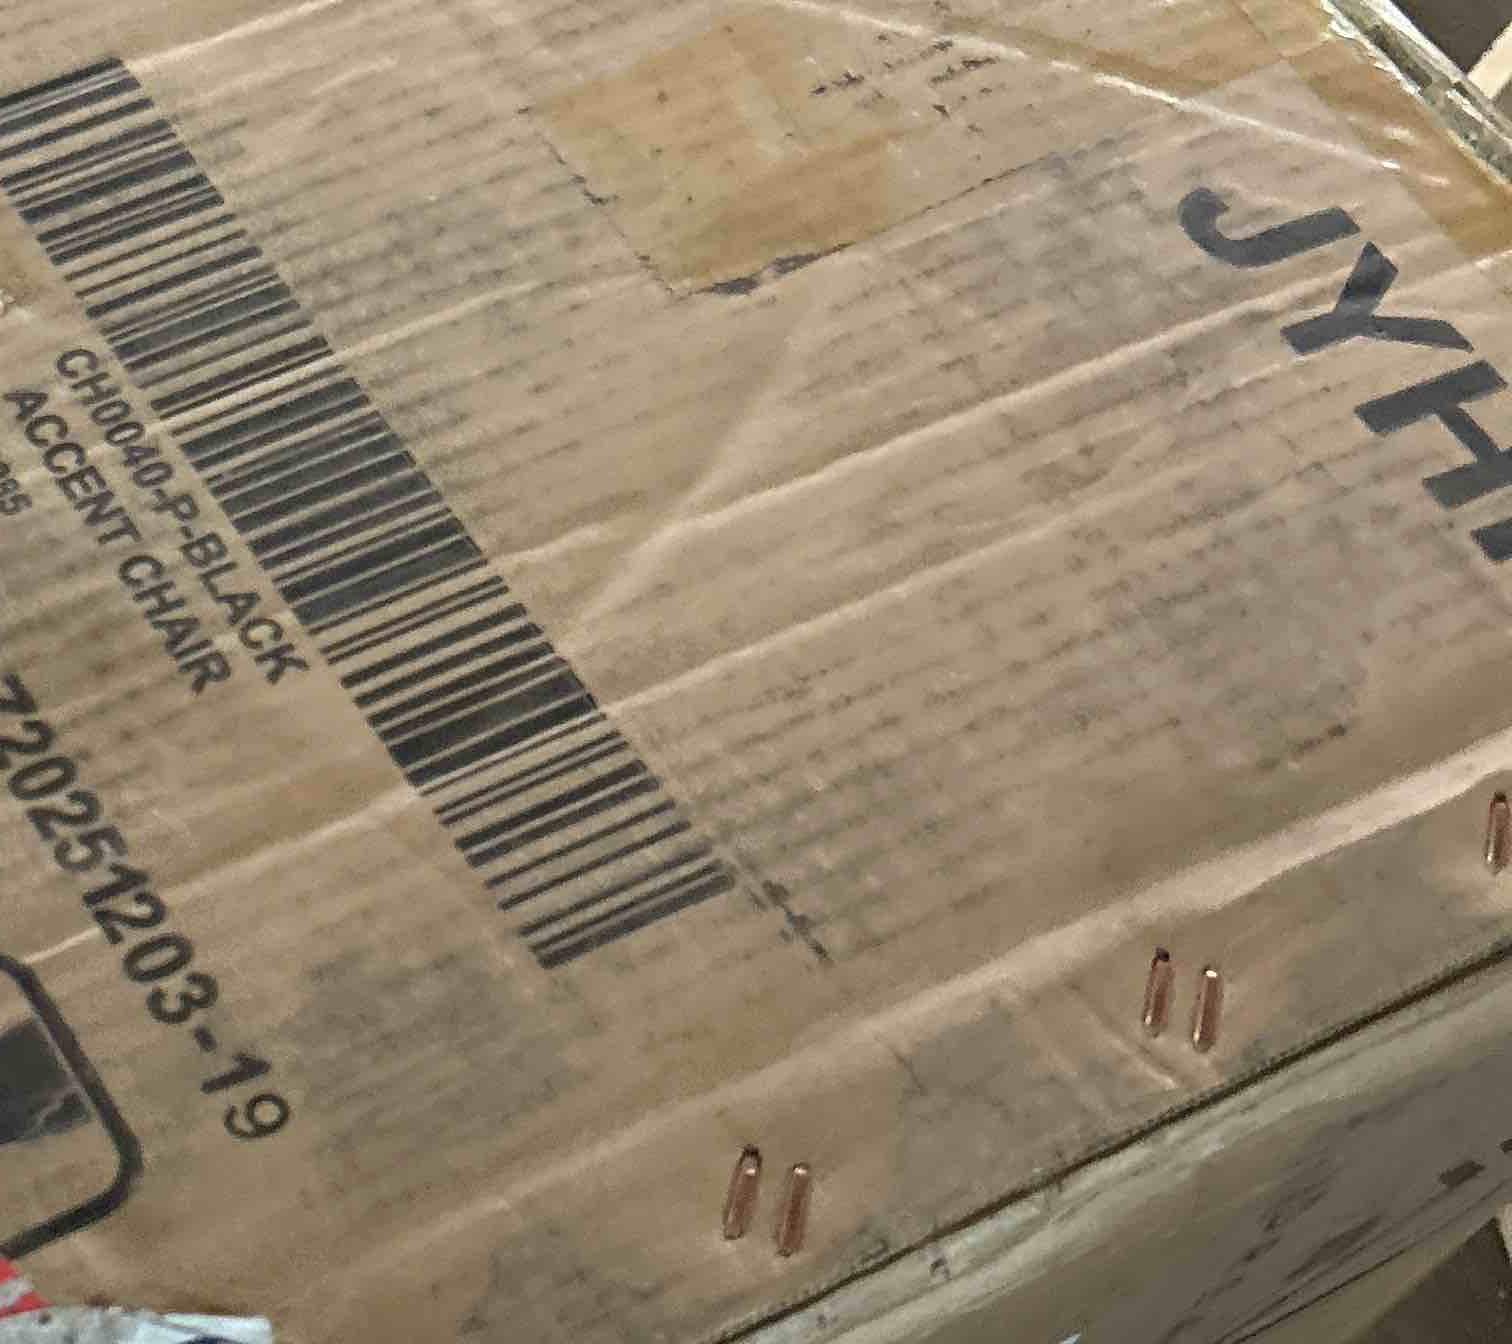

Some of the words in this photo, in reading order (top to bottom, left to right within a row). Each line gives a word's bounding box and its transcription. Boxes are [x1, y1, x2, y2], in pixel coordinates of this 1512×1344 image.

[3, 391, 142, 544] ACCENT
[119, 555, 231, 695] CHAIR
[56, 349, 310, 685] CH0040-P-BLACK
[1177, 188, 1512, 562] JYH
